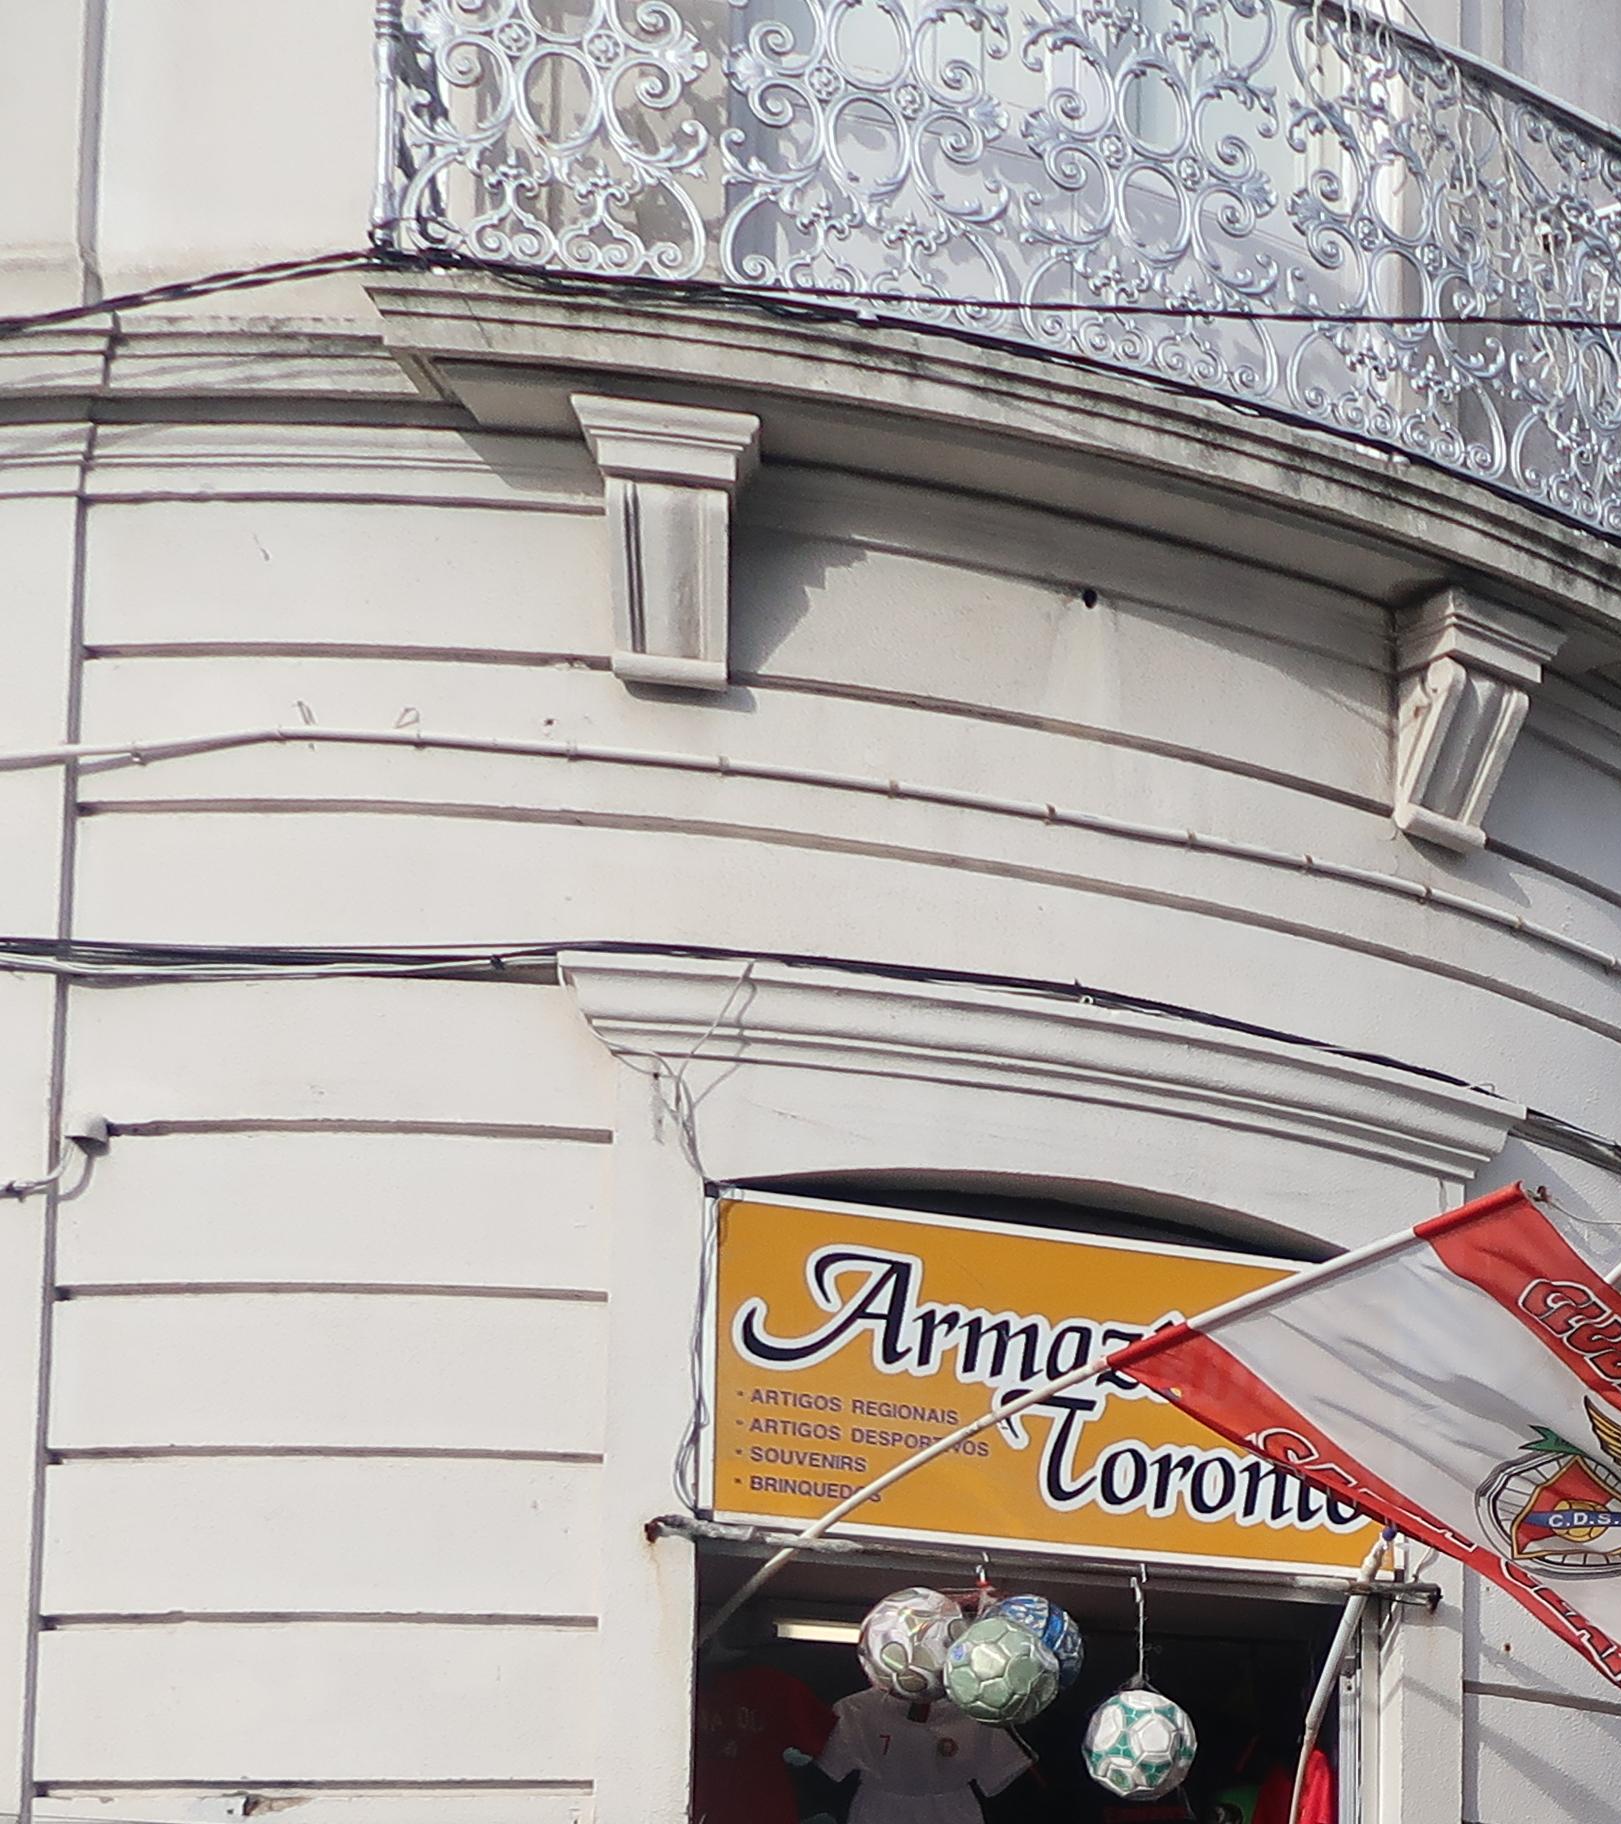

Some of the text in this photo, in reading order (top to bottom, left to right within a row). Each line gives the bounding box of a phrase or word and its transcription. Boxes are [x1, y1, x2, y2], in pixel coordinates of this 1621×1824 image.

[750, 1388, 960, 1426] ARTIGOS REGIONAIS
[749, 1417, 990, 1458] ARTIGOS DESPORVOS
[750, 1446, 868, 1473] SOUVENIRS
